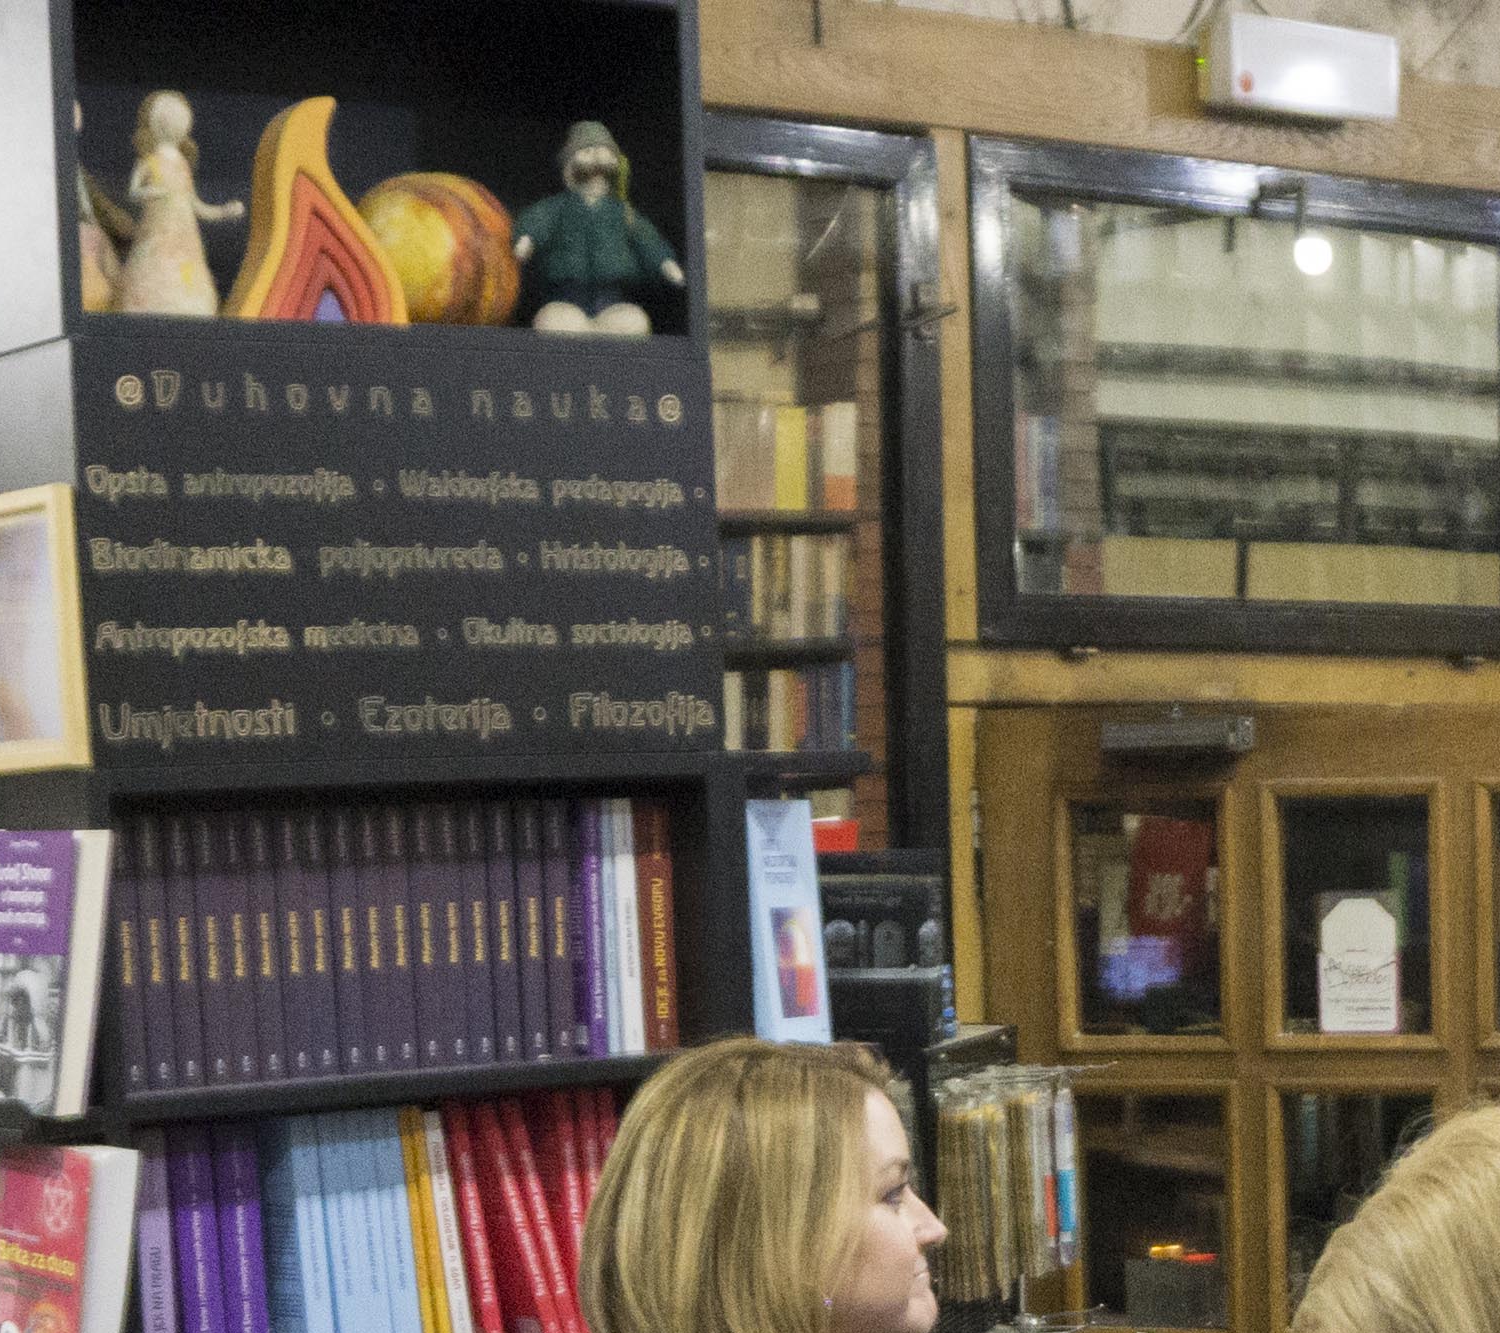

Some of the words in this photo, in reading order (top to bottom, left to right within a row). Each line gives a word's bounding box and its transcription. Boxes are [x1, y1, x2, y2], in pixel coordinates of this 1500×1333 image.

[399, 469, 540, 507] Waldorfska
[552, 474, 685, 509] pedagogija
[318, 538, 503, 578] poljoprivreda
[540, 539, 691, 578] Hristologija
[95, 618, 290, 656] Antropozofska
[304, 615, 419, 648] medicina
[462, 615, 558, 645] Okultna
[571, 617, 694, 650] sociologija
[99, 699, 296, 750] Umjetnosti
[357, 694, 512, 740] Ezoterija
[568, 690, 716, 736] Filozofija
